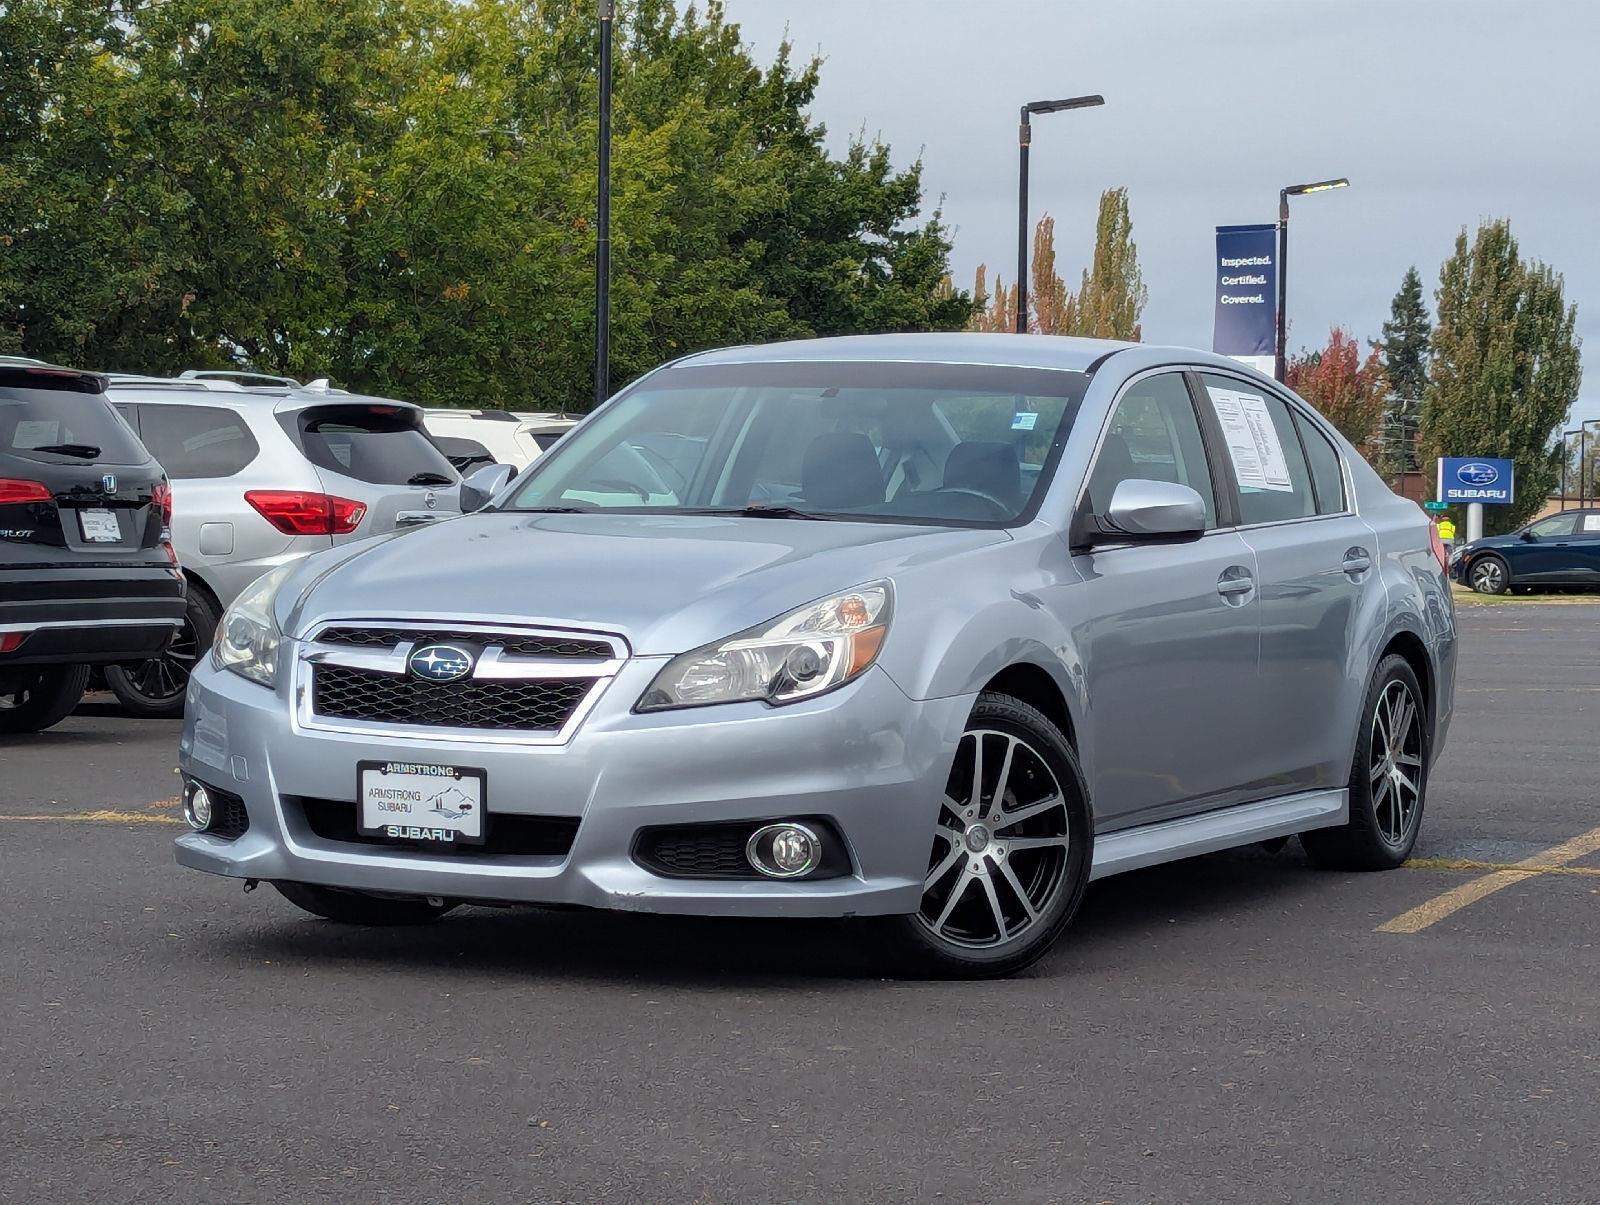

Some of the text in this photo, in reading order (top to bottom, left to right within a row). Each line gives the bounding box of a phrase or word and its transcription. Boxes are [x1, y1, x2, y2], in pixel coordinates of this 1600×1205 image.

[1221, 255, 1272, 268] Inspected.
[1221, 274, 1267, 285] Certified.
[1220, 294, 1265, 304] Covered.
[1448, 489, 1506, 498] SUBARU
[386, 763, 454, 776] ARMSTRONG
[369, 788, 421, 801] ARMSTRONG
[378, 802, 412, 813] SUBARU
[387, 826, 454, 841] SUBARU
